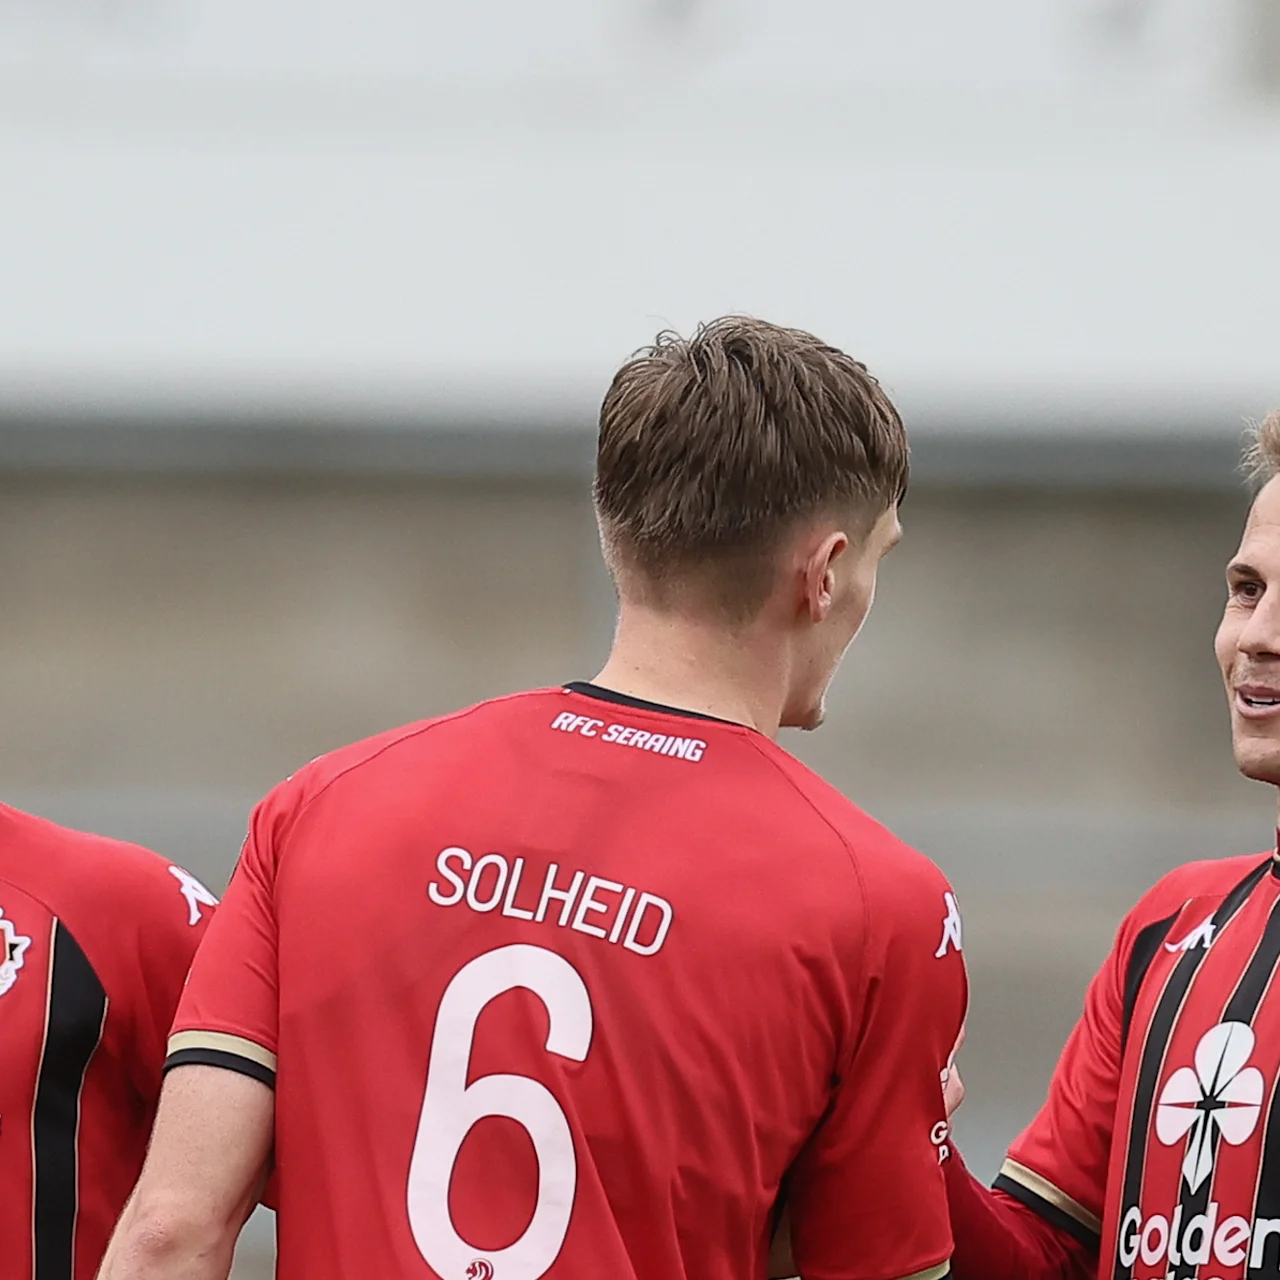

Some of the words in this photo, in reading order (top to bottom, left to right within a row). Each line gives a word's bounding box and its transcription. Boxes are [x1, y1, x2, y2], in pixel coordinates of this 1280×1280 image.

[551, 712, 605, 737] RFC
[601, 724, 707, 762] SERAING
[427, 846, 674, 957] SOLHEID
